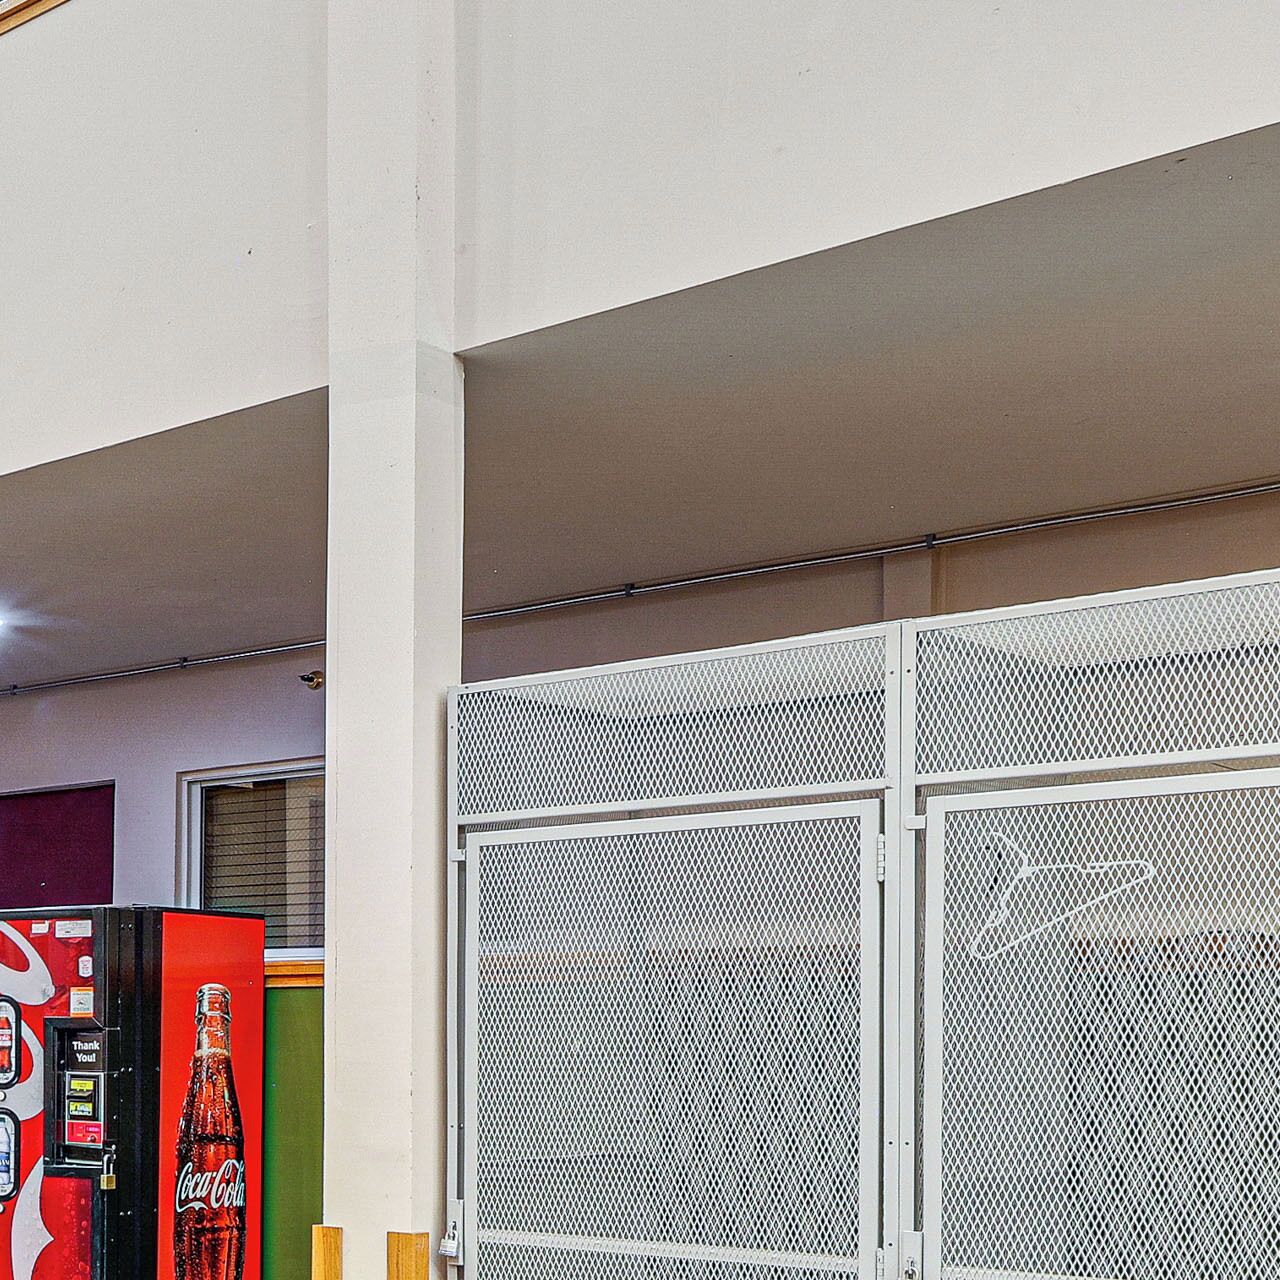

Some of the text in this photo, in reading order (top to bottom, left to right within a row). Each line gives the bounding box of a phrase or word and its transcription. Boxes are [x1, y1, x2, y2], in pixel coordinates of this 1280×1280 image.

[72, 1041, 100, 1051] Thank
[76, 1053, 96, 1063] You!
[175, 1159, 245, 1213] Coca-Cola
